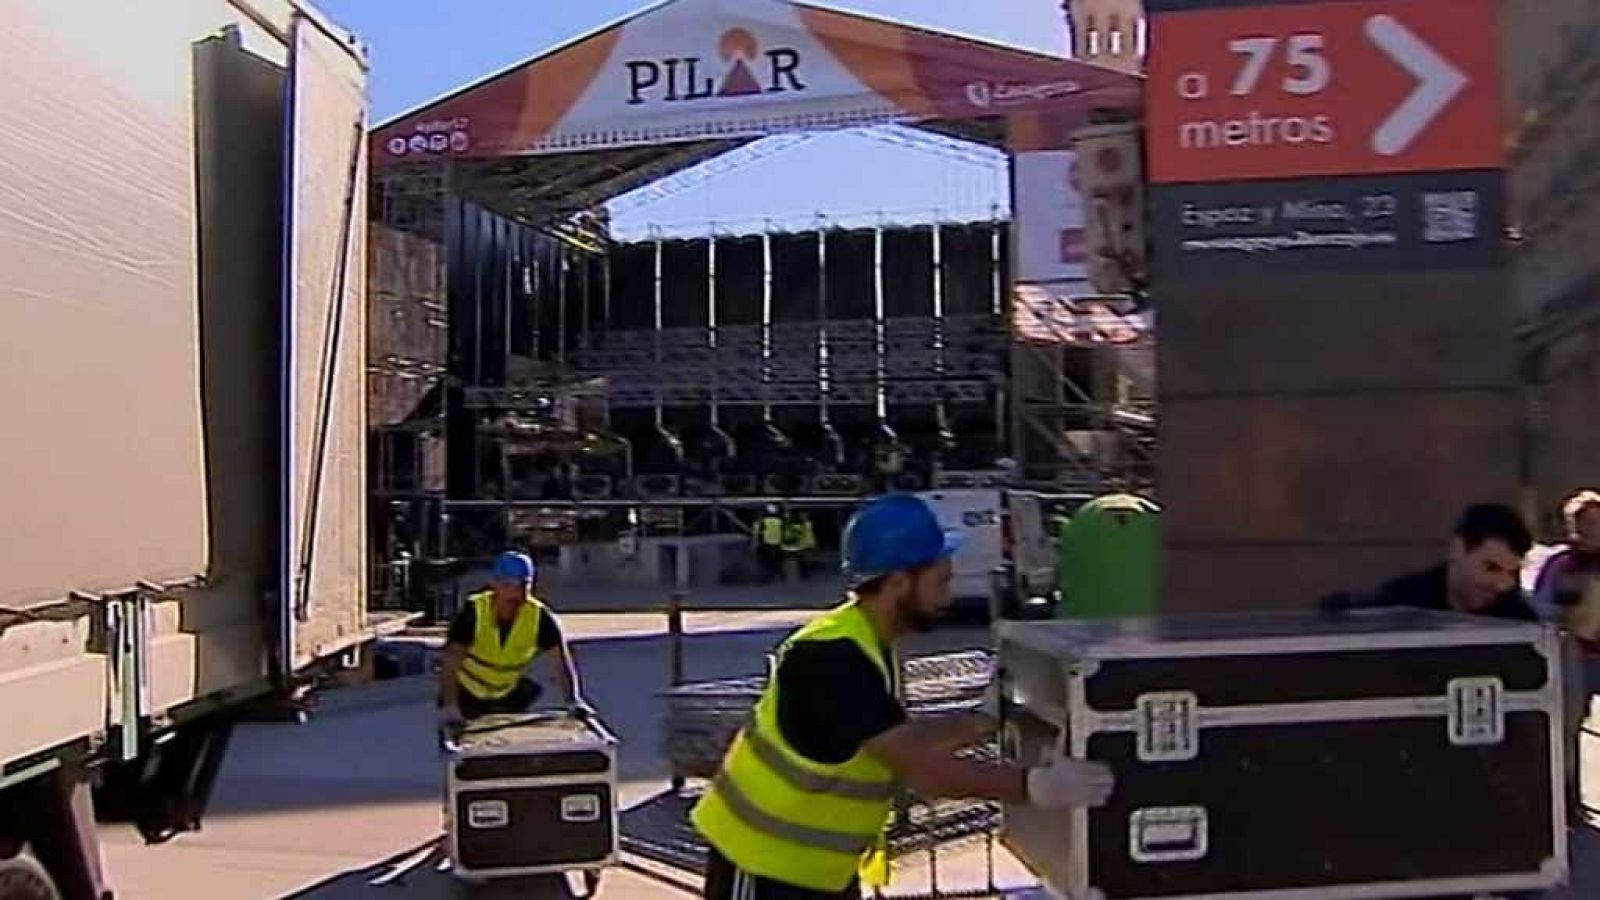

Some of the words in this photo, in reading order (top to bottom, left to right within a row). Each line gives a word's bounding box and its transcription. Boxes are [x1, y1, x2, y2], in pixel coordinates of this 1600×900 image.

[625, 47, 807, 105] PILAR
[1178, 73, 1209, 99] a
[1227, 34, 1330, 95] 75
[1180, 112, 1332, 149] metros
